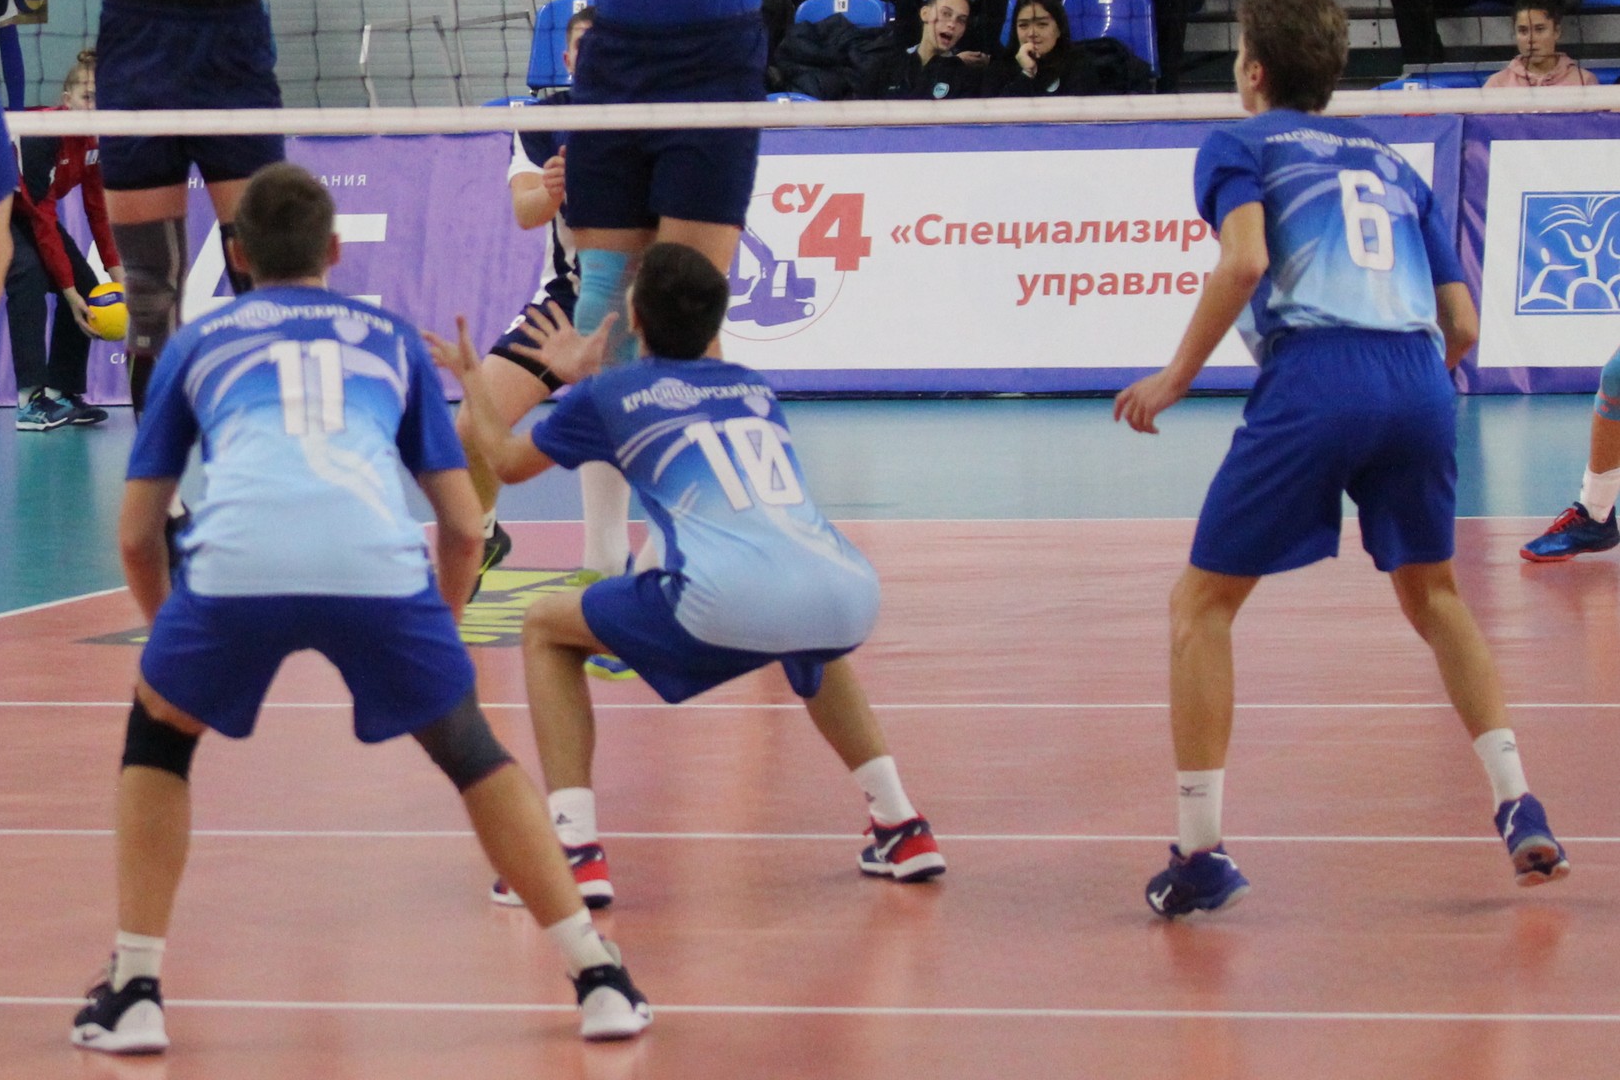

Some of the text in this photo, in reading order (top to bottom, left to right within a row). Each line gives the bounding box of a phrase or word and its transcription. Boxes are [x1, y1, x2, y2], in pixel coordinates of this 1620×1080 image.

[771, 182, 873, 271] СУ 4
[890, 213, 1221, 252] «Специализир
[1338, 169, 1394, 271] 6
[269, 339, 346, 436] 11
[683, 416, 805, 513] 10
